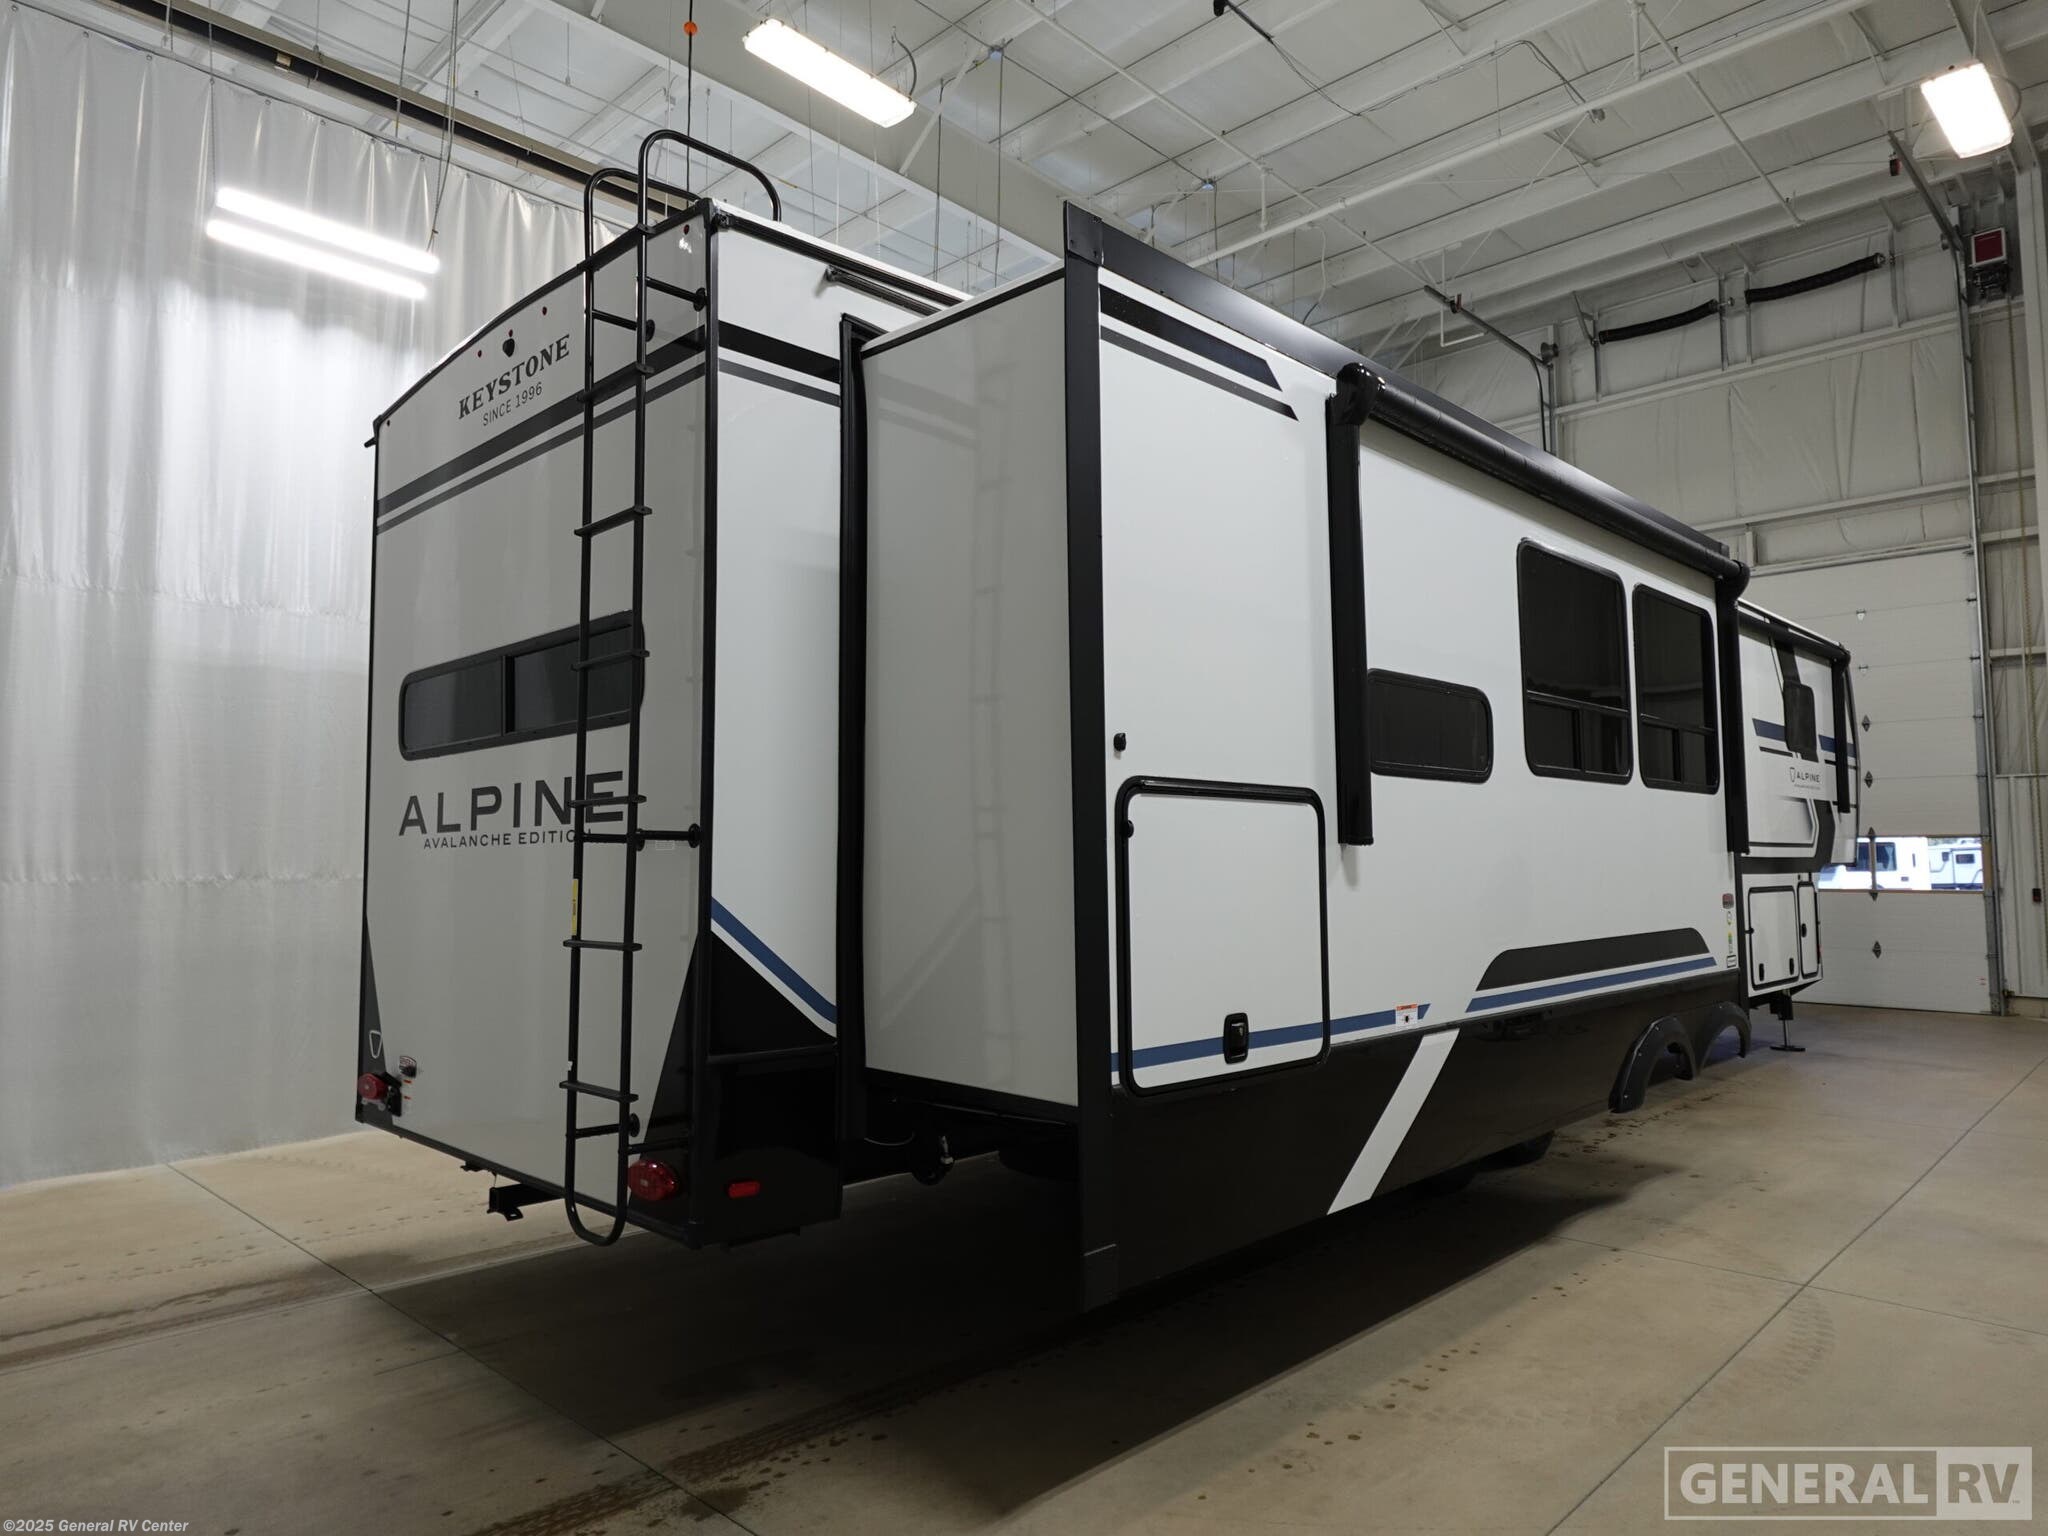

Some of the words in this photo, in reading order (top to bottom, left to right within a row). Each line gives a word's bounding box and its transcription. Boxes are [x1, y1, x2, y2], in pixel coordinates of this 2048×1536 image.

[458, 334, 570, 420] KEYSTONE
[482, 399, 512, 427] SINCE
[515, 381, 543, 408] 1996
[1796, 771, 1821, 783] ALPINE
[399, 771, 624, 836] ALPINE
[423, 832, 511, 849] AVALANCHE
[518, 828, 592, 845] EDITIO
